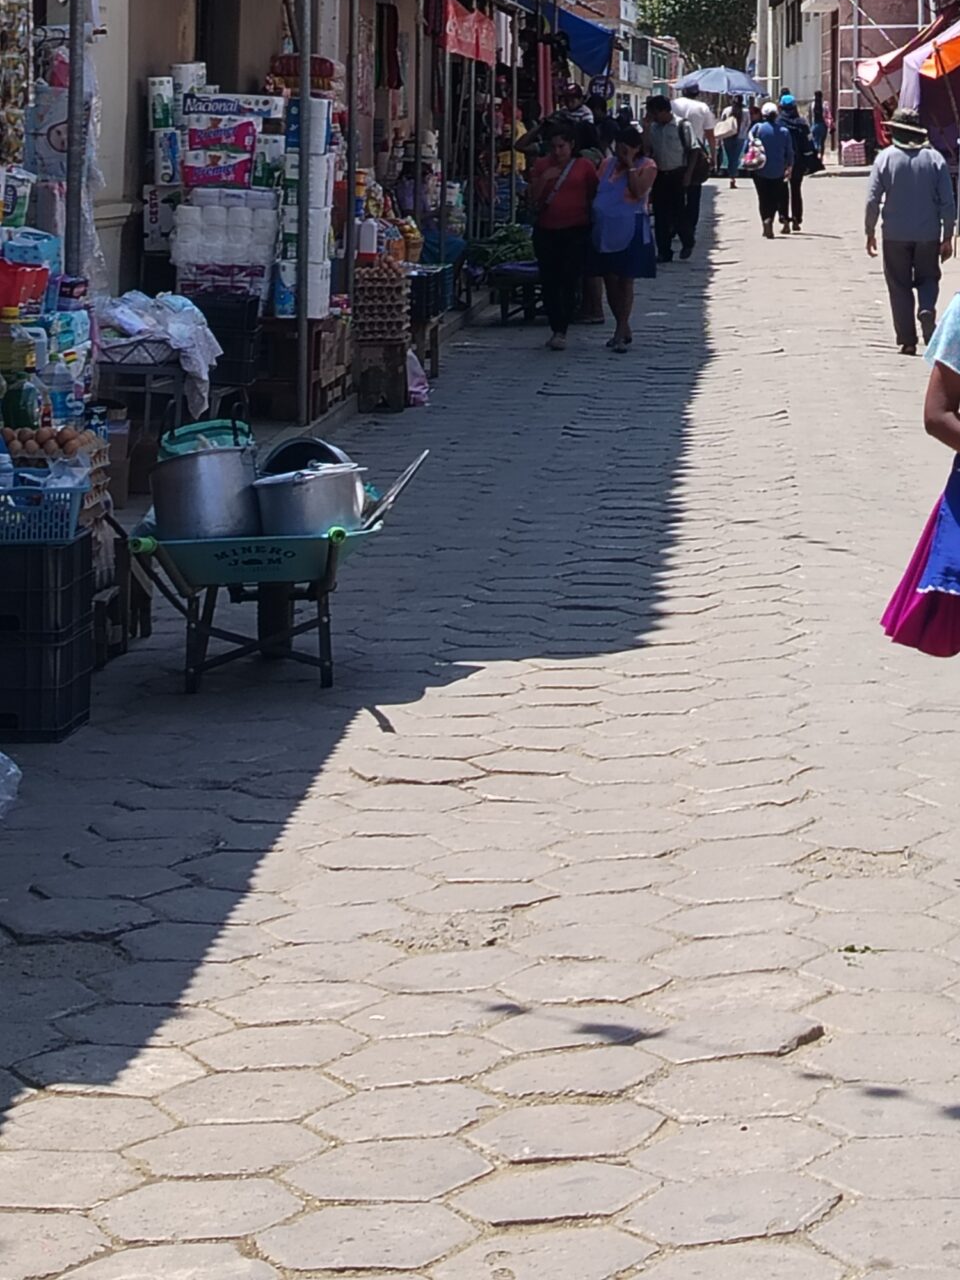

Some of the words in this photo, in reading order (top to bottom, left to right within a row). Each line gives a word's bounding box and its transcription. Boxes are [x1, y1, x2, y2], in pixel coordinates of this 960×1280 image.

[185, 100, 239, 113] Nacional
[149, 190, 159, 225] CESTA
[213, 545, 297, 561] MINERO
